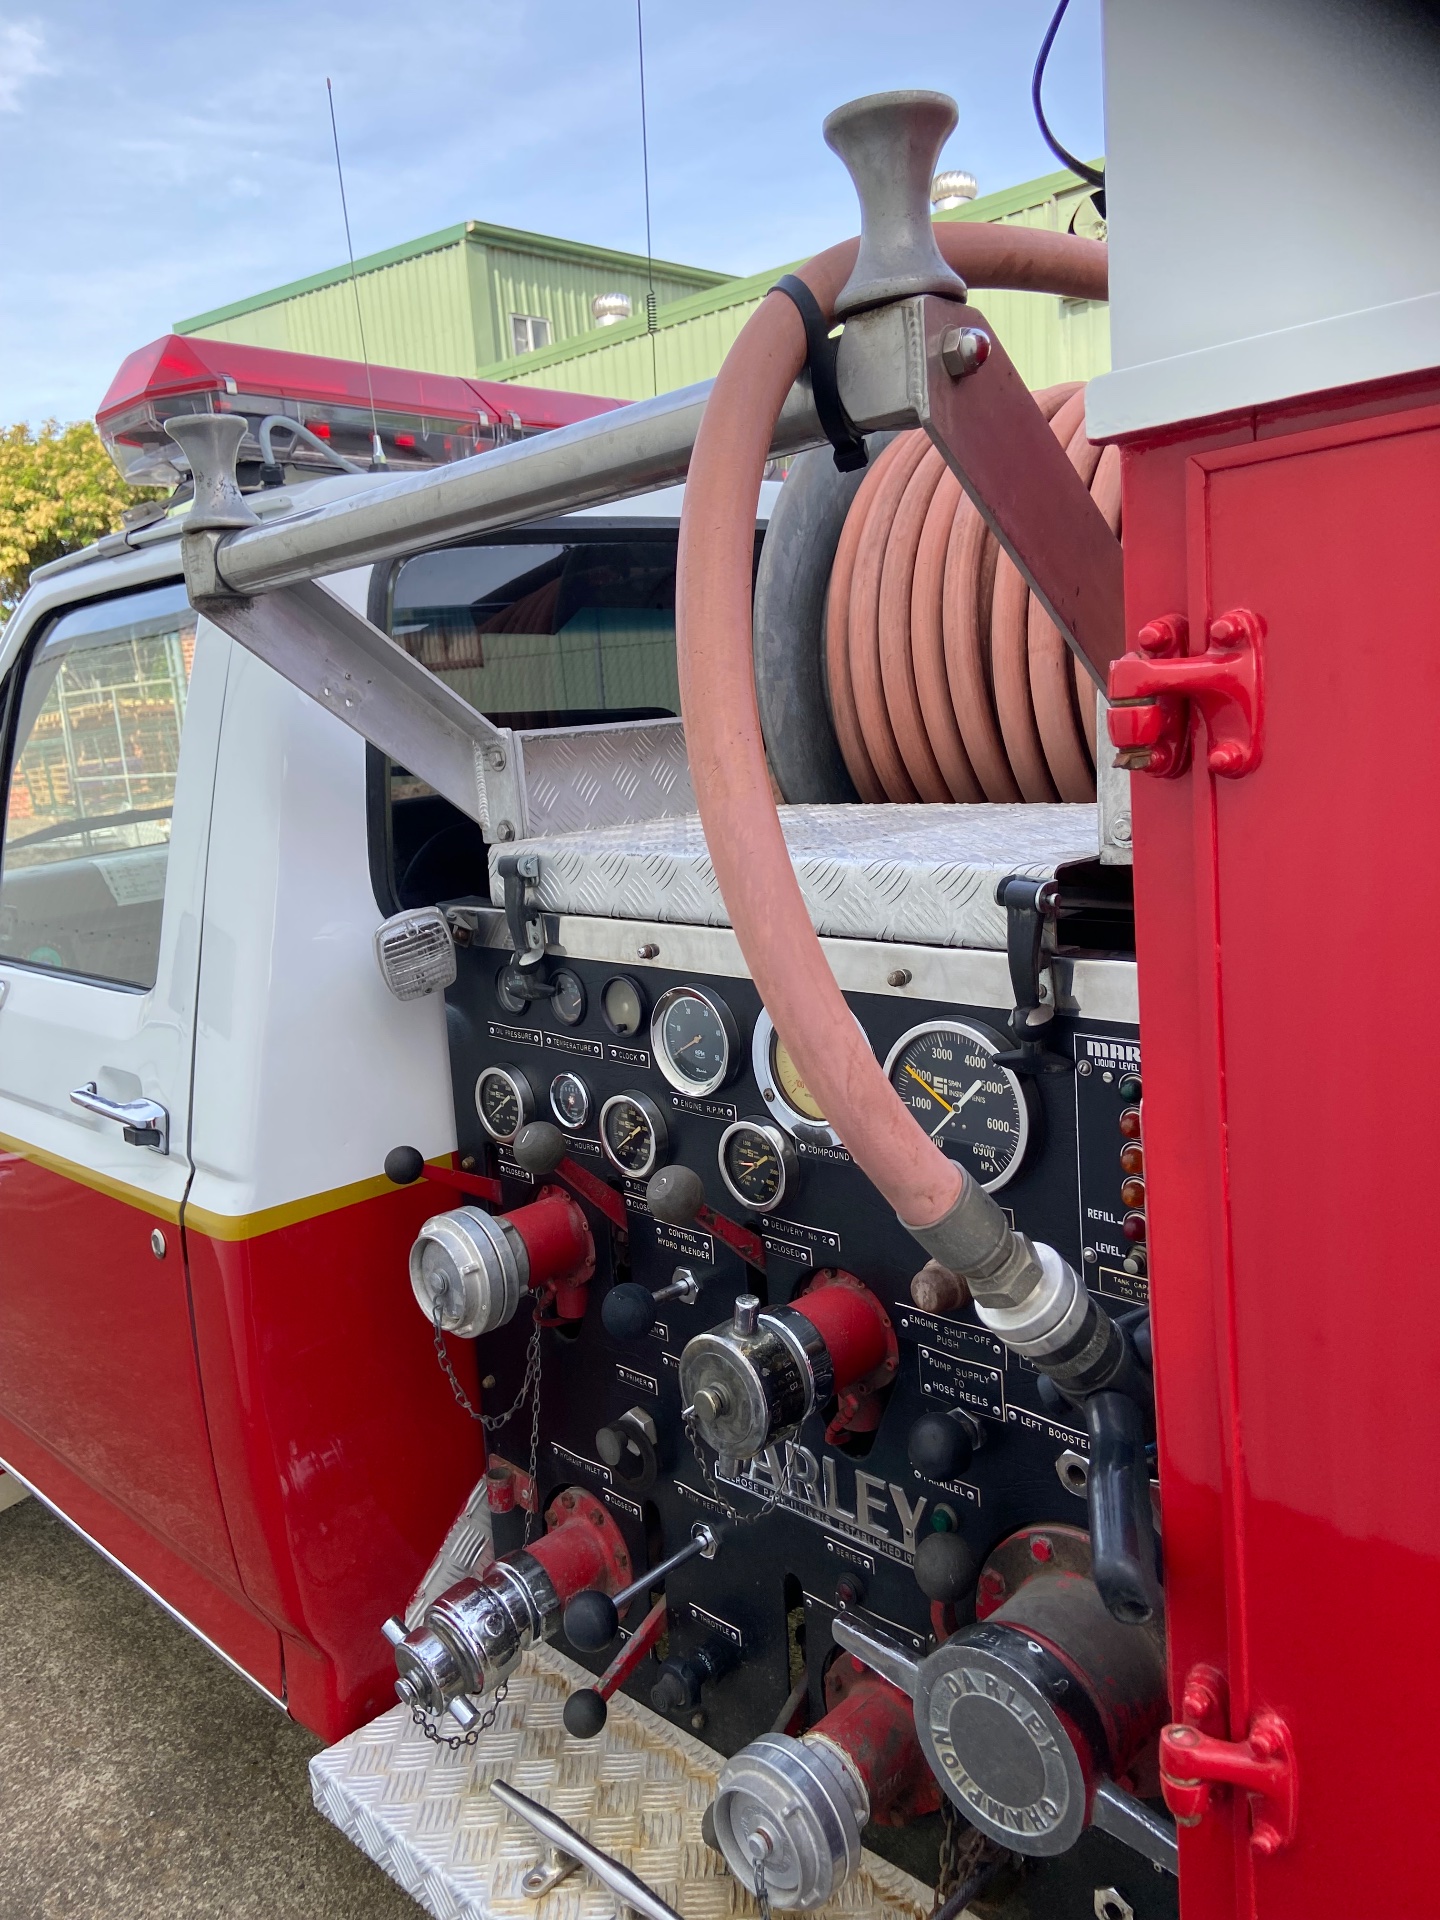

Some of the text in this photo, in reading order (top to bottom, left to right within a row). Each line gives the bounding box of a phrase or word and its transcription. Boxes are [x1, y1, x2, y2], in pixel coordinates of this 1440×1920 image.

[504, 1029, 533, 1041] PRESSURE
[553, 1038, 592, 1052] TEMPERATURE
[618, 1051, 638, 1061] CLOCK
[931, 1047, 953, 1061] 3000
[964, 1055, 987, 1069] 4000
[1094, 1057, 1140, 1072] LIQUID LEVEL
[981, 1080, 1004, 1095] 5000
[911, 1095, 932, 1110] 1000
[948, 1090, 986, 1104] INSTRENTS
[680, 1099, 726, 1116] ENGINE R.P.M.
[986, 1117, 1010, 1133] 6000
[574, 1142, 595, 1152] HOURS
[807, 1145, 850, 1162] COMPOUND
[972, 1142, 996, 1159] 6900
[505, 1166, 526, 1178] CLOSED
[980, 1160, 994, 1173] kPa
[1087, 1207, 1116, 1224] REFILL
[668, 1228, 697, 1243] CONTROL
[770, 1220, 804, 1237] DELIVERY
[657, 1237, 710, 1260] HYDRO BLENDER
[772, 1243, 801, 1258] CLOSED
[1095, 1241, 1121, 1257] LEVEL
[1113, 1276, 1130, 1286] TANK
[909, 1314, 991, 1346] ENGINE SHUT-OFF
[936, 1335, 959, 1349] PUSH
[929, 1357, 990, 1384] PUMP SUPPLY
[625, 1372, 648, 1387] PRIMER
[953, 1377, 965, 1389] TO
[932, 1381, 989, 1407] HOSE REELS
[1020, 1415, 1091, 1450] LEFT BOOSTE
[584, 1464, 601, 1476] INLET
[742, 1440, 928, 1553] ARLEY
[610, 1496, 633, 1513] CLOSED
[702, 1500, 724, 1515] REFILL
[836, 1547, 862, 1565] SERIES
[700, 1613, 730, 1636] THROTTLE
[943, 1668, 1062, 1758] DARLEY
[932, 1725, 1060, 1832] CHAMPION
